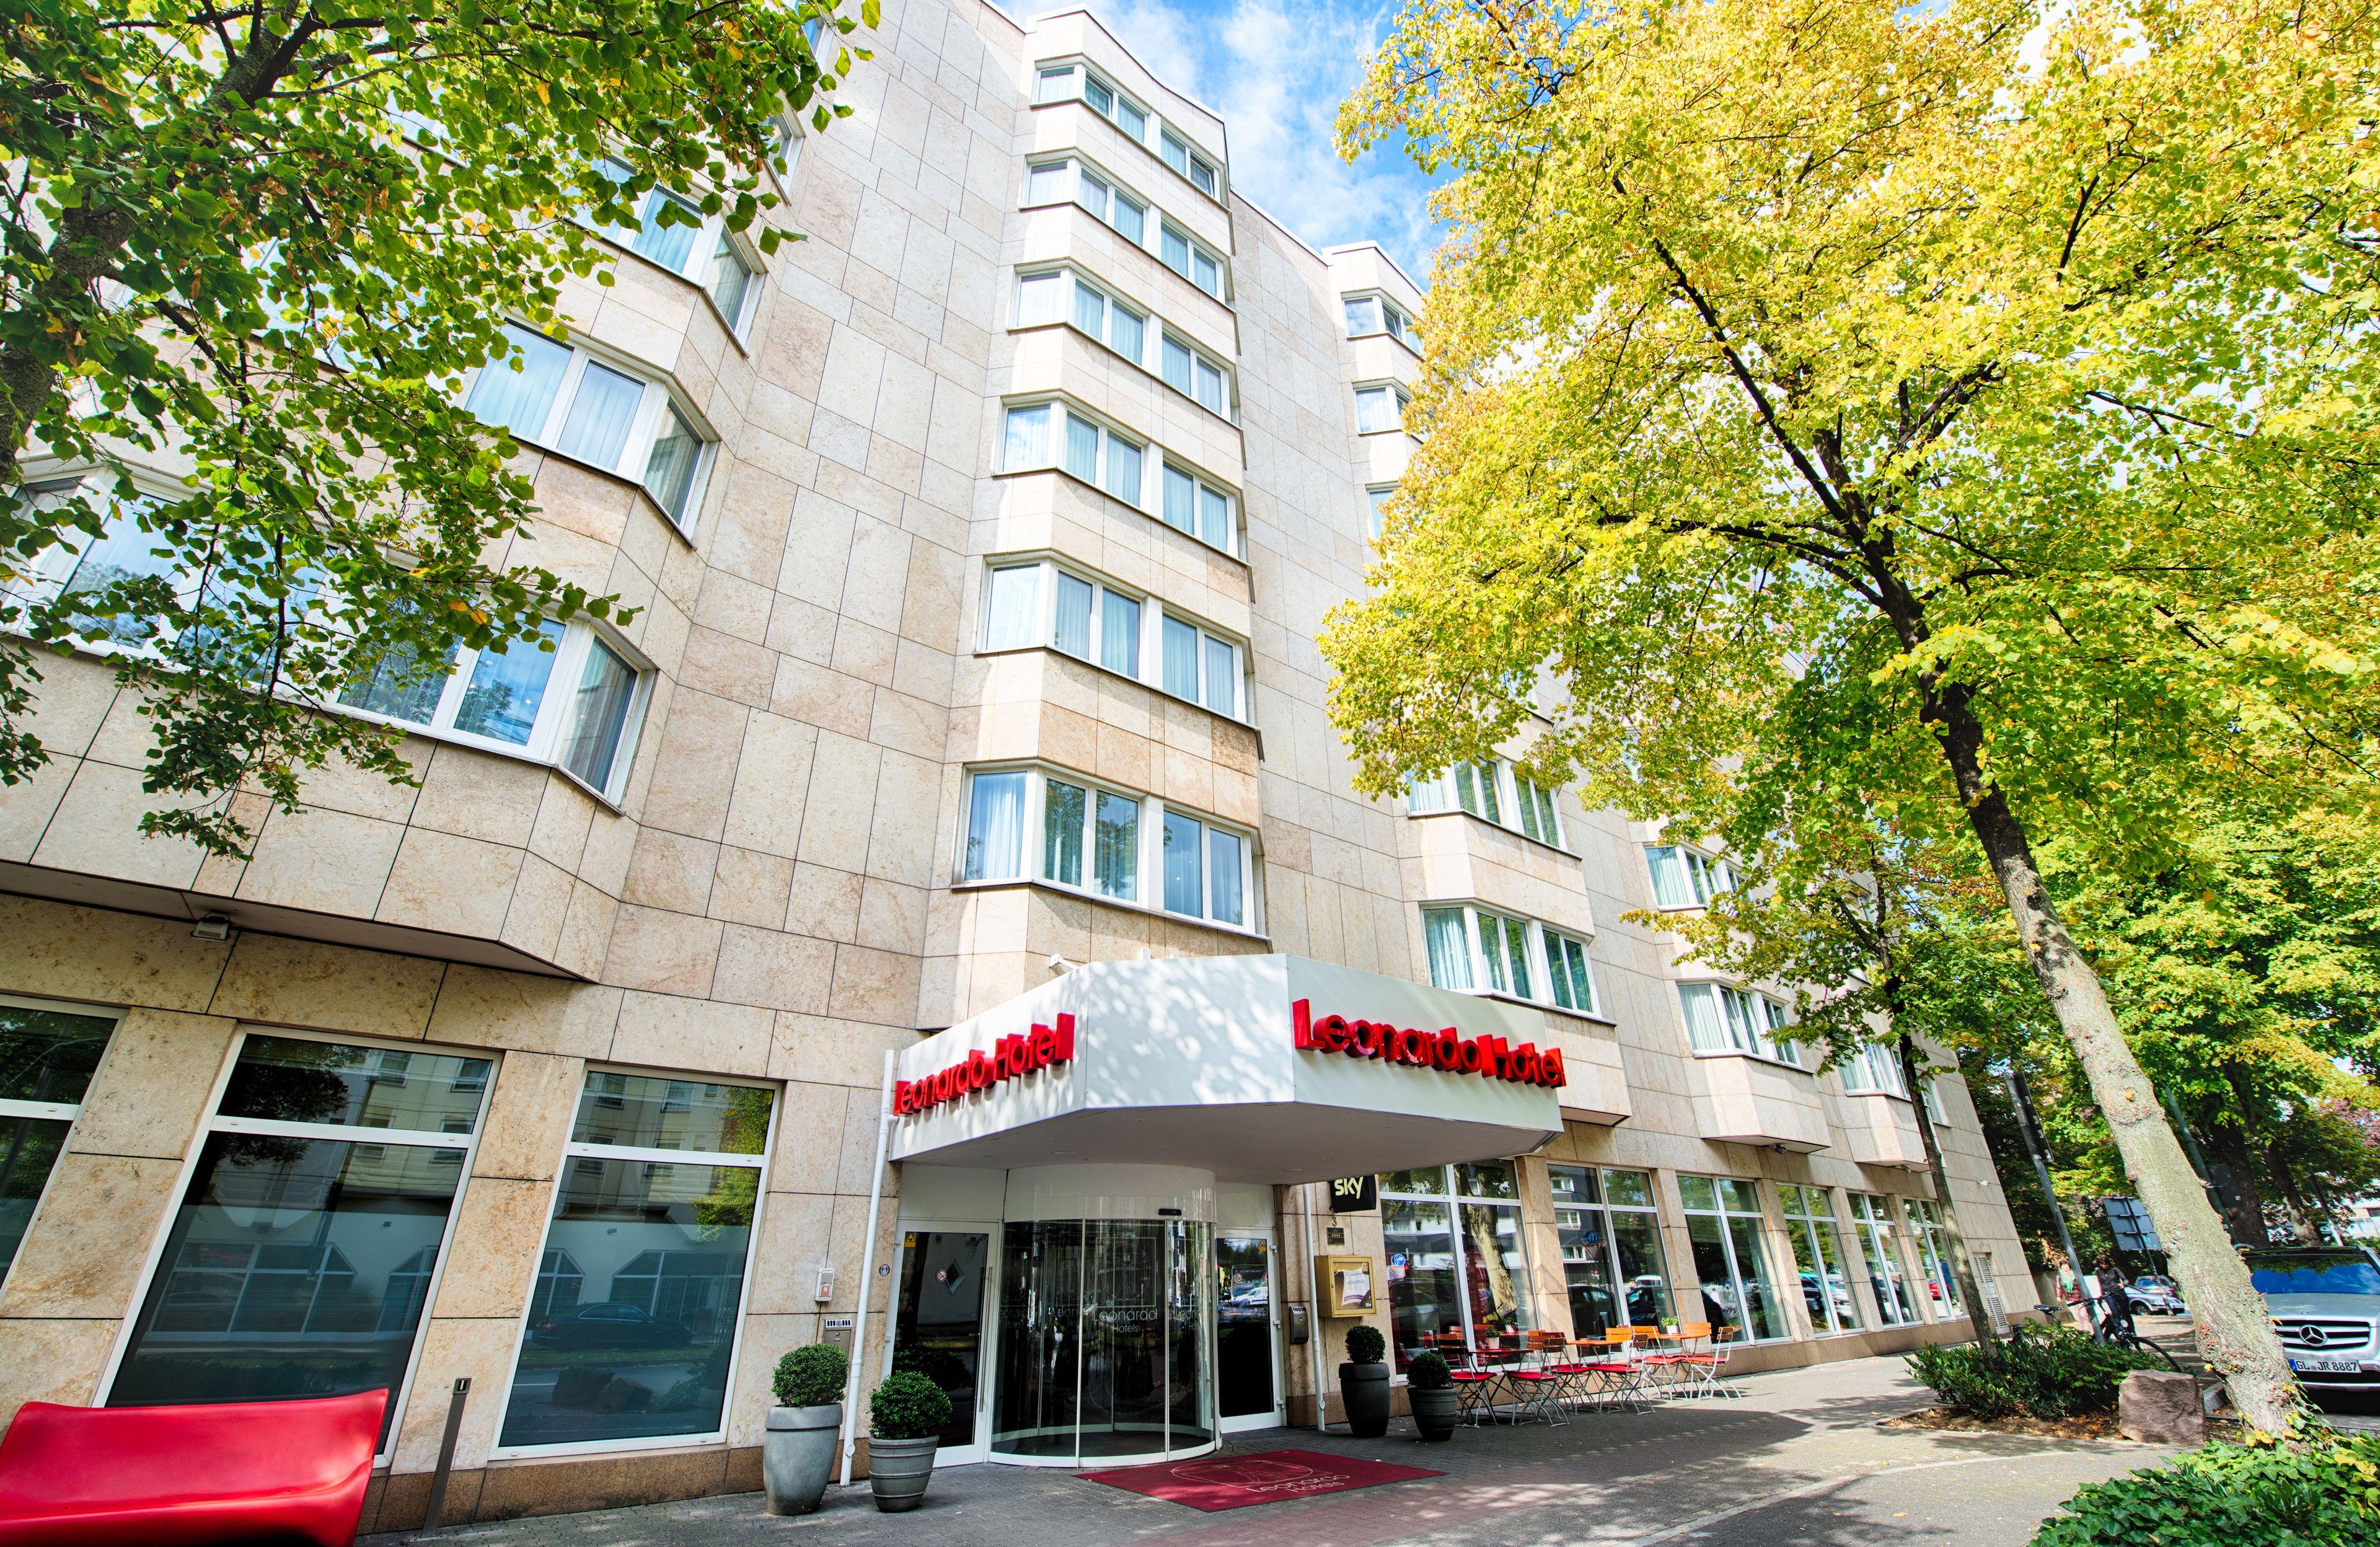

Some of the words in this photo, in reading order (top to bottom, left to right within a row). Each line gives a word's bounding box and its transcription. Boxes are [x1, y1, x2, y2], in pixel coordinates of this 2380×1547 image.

[1292, 998, 1482, 1074] Leonardo
[1477, 1034, 1567, 1088] Hotel
[893, 1049, 994, 1116] Leonardo
[994, 1013, 1075, 1082] Hotel
[1093, 1308, 1156, 1321] Leonardo
[1113, 1324, 1139, 1333] Hotels
[2296, 1360, 2310, 1370] GL
[2317, 1361, 2330, 1370] JR
[2332, 1362, 2357, 1371] 8887
[1246, 1474, 1350, 1492] Leonardo
[1285, 1481, 1345, 1492] Hotels
